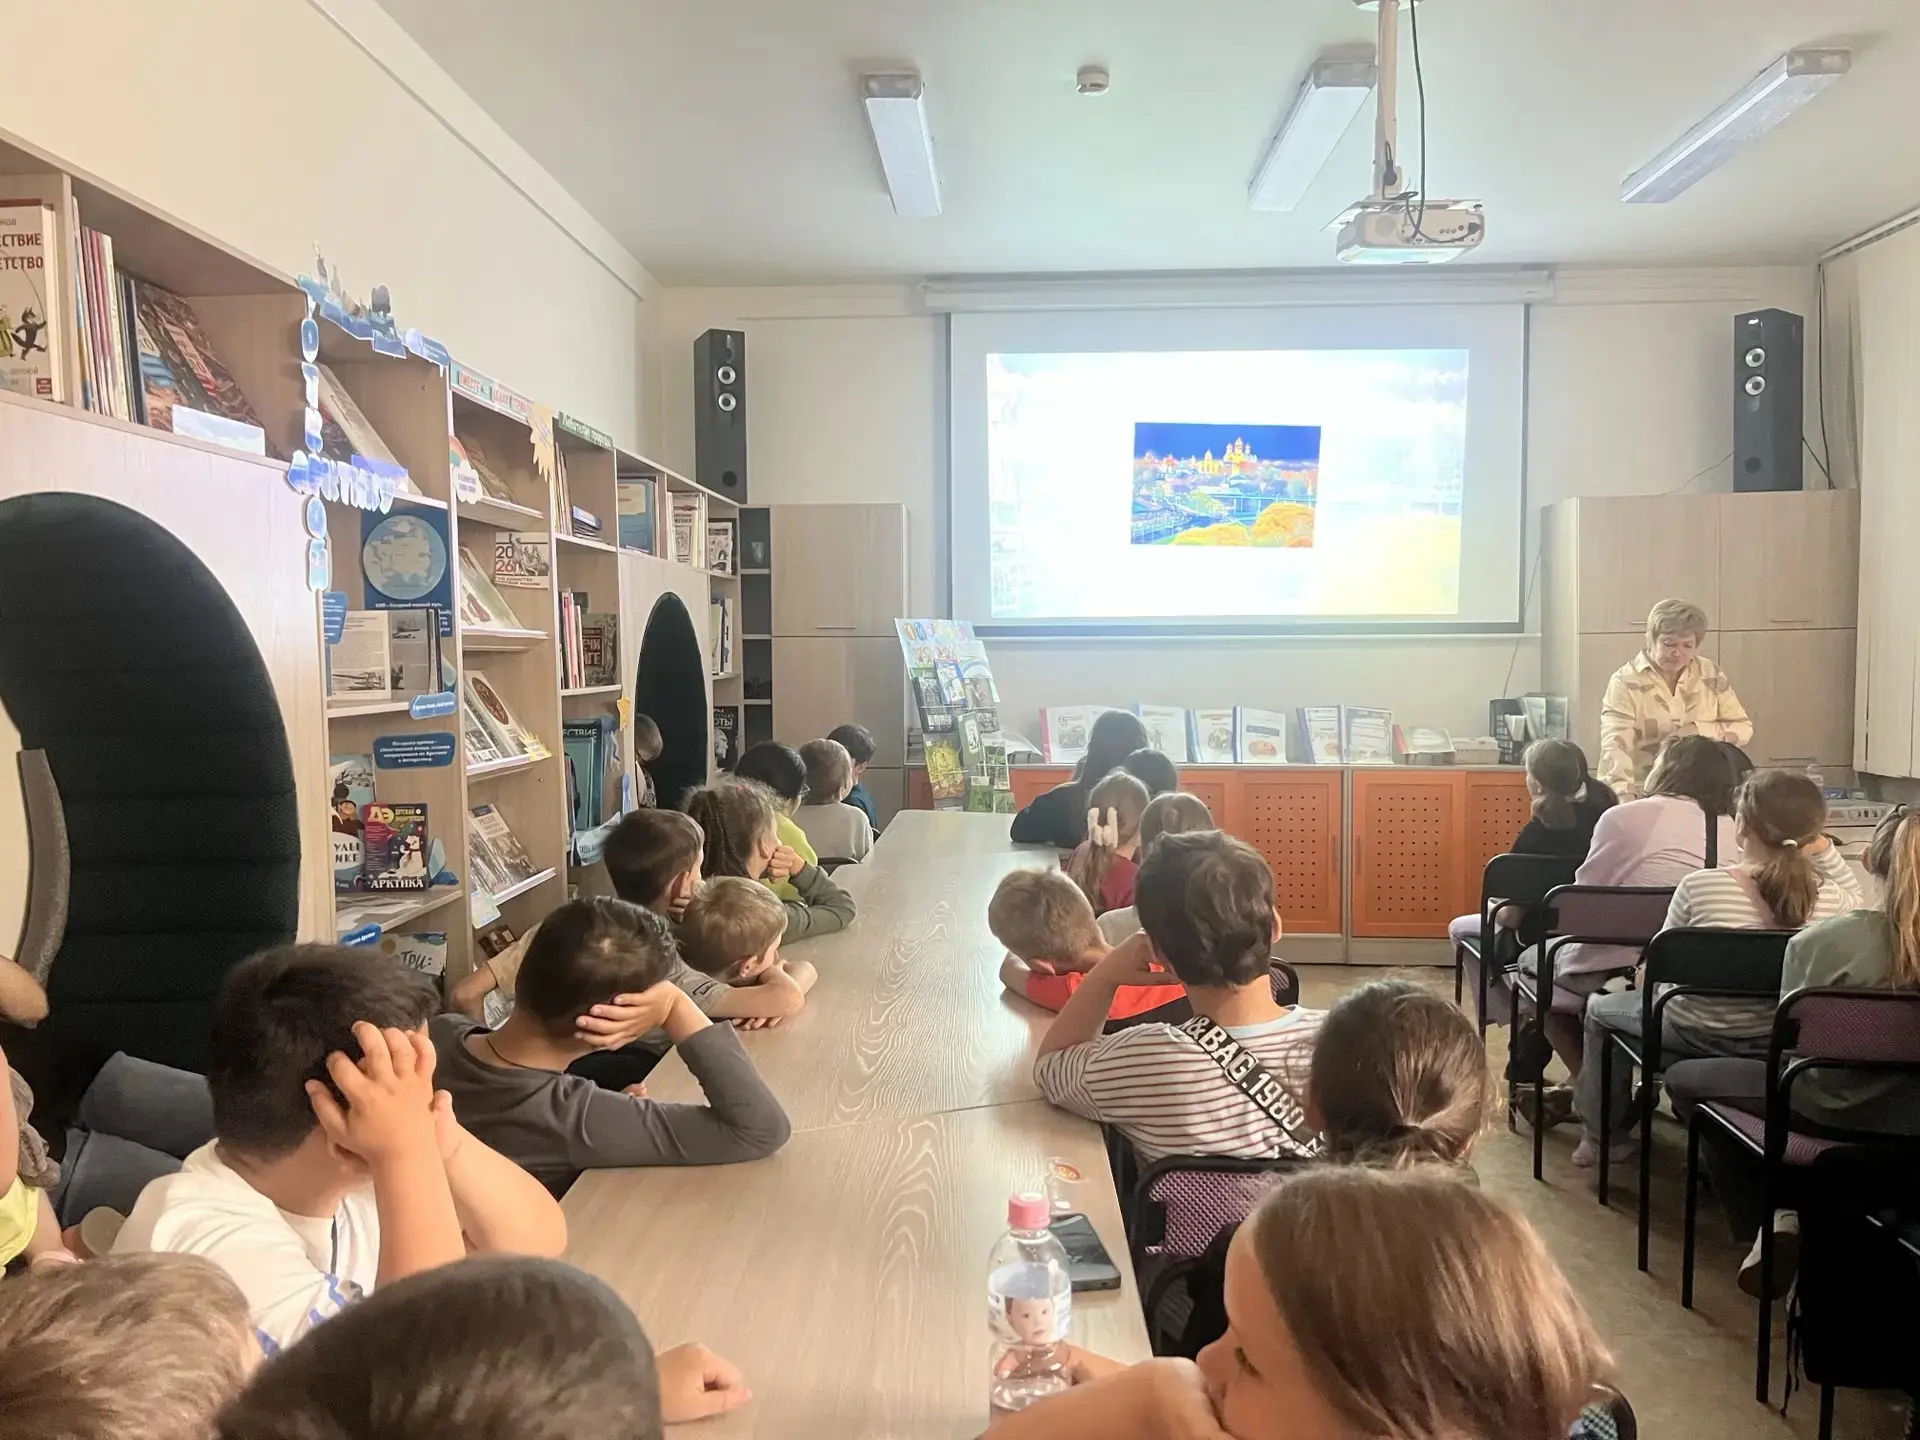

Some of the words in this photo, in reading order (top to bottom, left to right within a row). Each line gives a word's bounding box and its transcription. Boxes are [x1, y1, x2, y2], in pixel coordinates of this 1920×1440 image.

[0, 233, 42, 247] СТВИЕ
[495, 545, 513, 558] 20
[495, 559, 514, 572] 26
[370, 879, 424, 889] АРКТИКА
